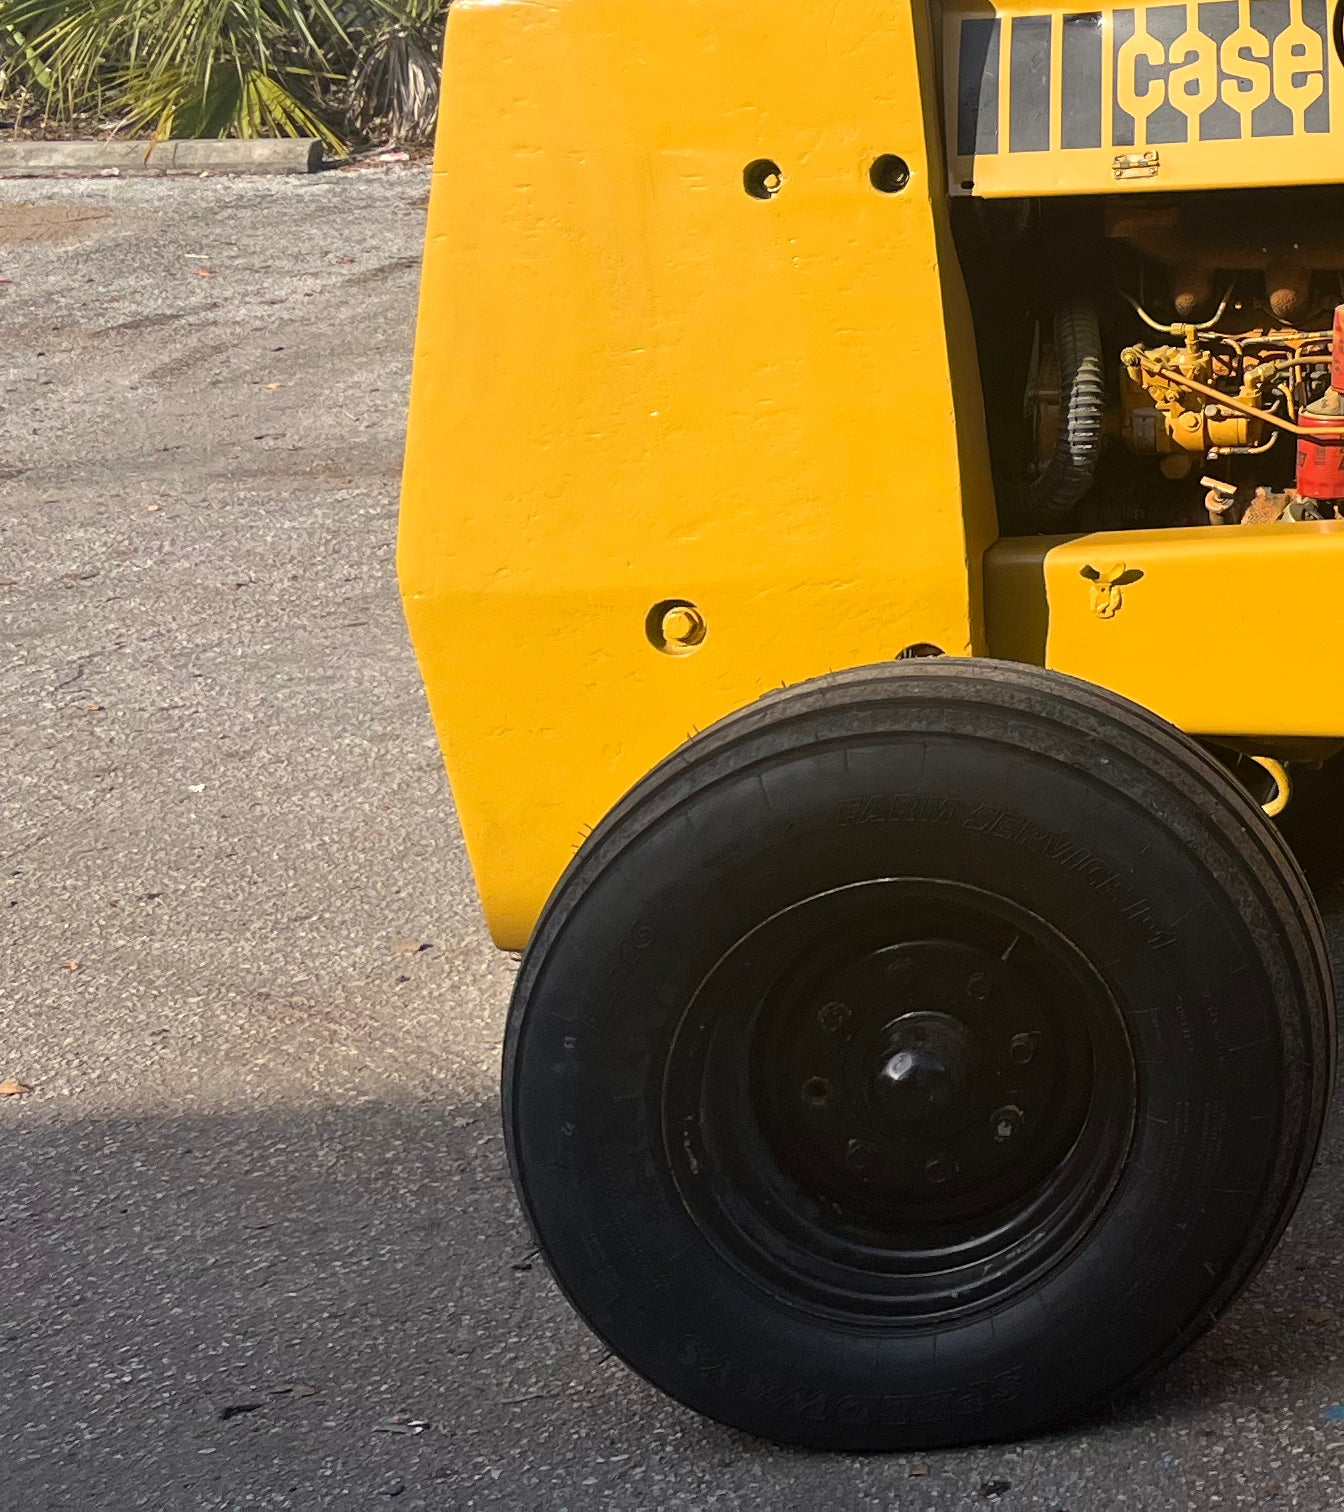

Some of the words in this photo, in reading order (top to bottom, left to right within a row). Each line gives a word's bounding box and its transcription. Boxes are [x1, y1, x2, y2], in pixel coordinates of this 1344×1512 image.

[1114, 18, 1326, 128] case
[837, 793, 960, 828] FARM
[962, 802, 1133, 897] SERVICE
